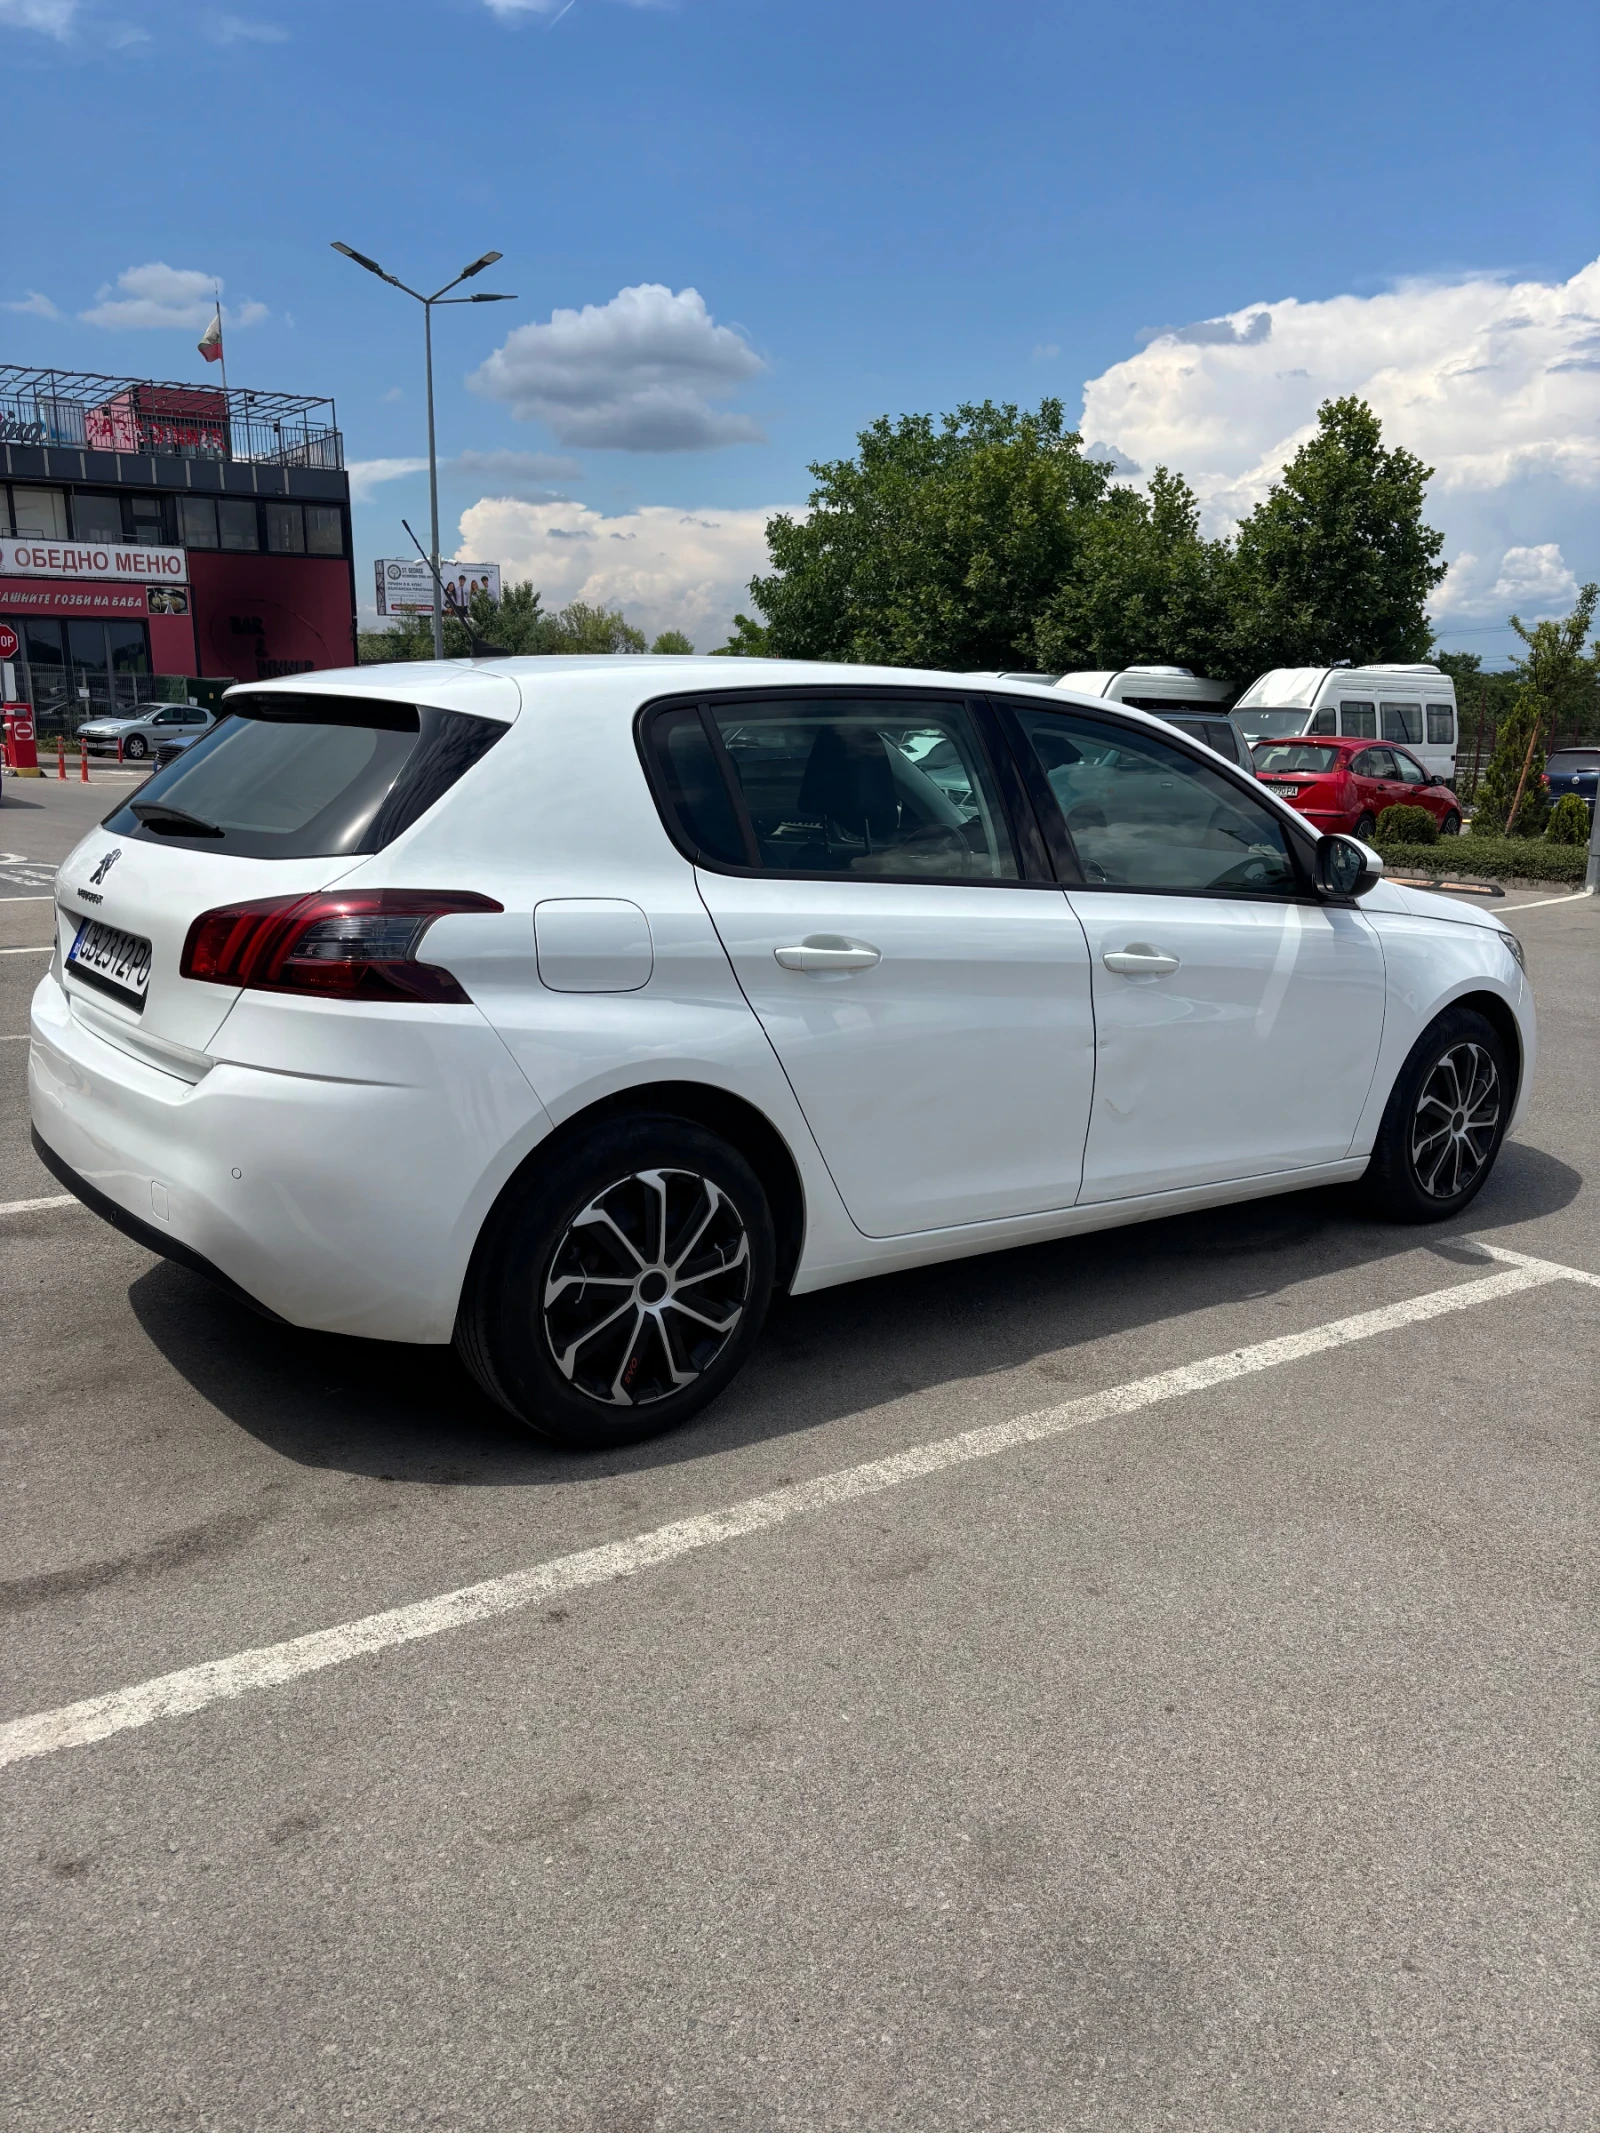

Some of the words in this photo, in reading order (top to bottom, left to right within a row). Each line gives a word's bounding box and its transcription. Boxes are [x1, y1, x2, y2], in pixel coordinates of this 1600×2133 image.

[14, 547, 109, 573] ОБЕДНО
[115, 552, 181, 575] МЕНЮ
[0, 591, 50, 604] АШНИТЕ
[54, 594, 91, 606] ГОЗБИ
[94, 594, 109, 606] НА
[111, 595, 142, 607] БАБА
[229, 615, 265, 635] BAR
[255, 660, 315, 677] DINNER
[625, 1357, 637, 1384] EVO
